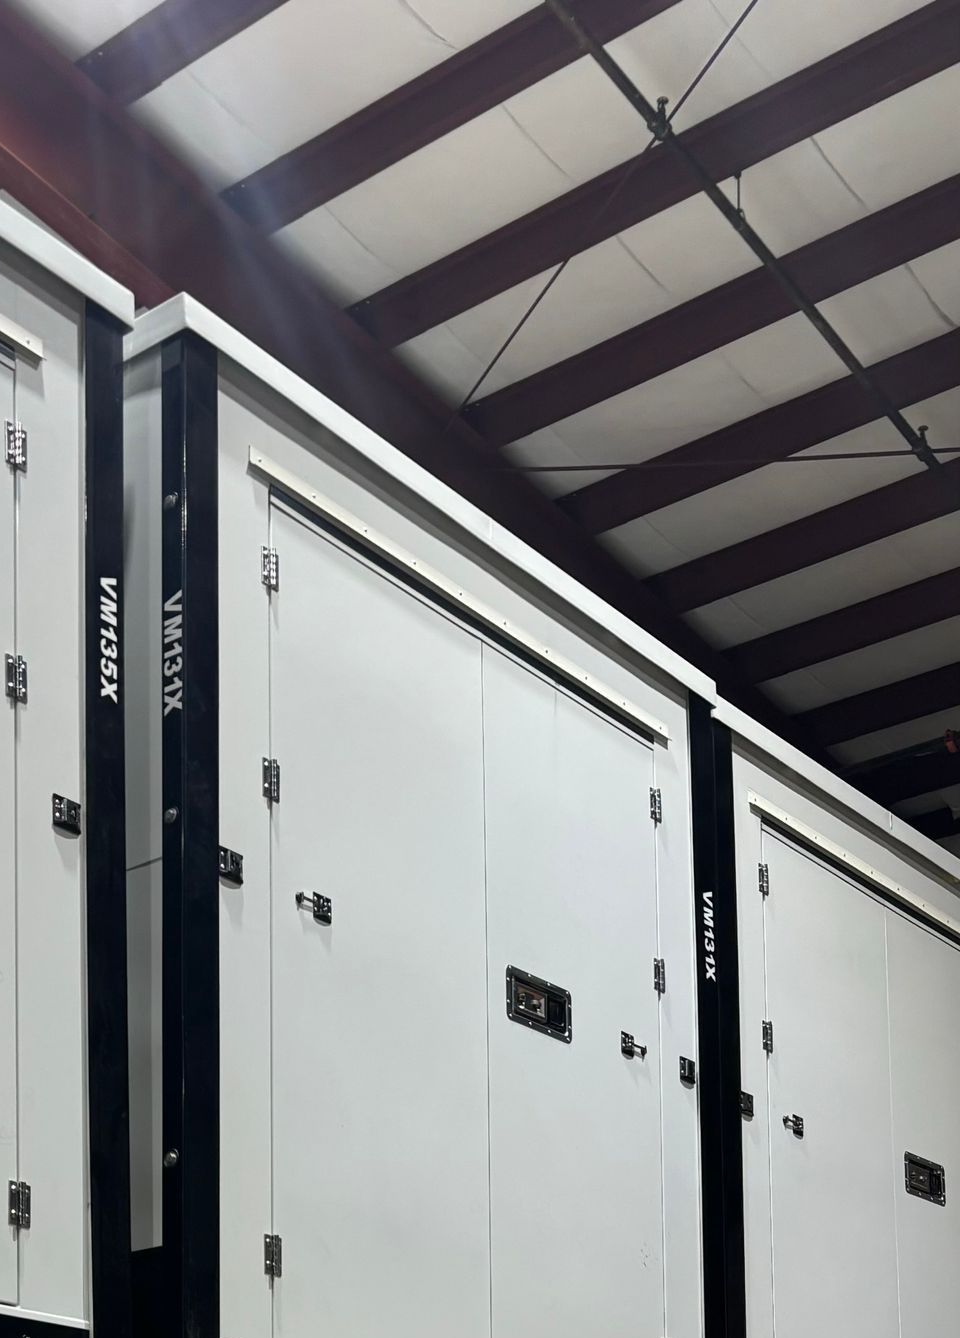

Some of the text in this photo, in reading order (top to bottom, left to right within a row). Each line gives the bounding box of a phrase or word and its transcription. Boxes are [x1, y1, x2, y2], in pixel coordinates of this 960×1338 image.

[100, 577, 118, 704] VM135X
[164, 589, 183, 717] VM131X
[702, 891, 716, 982] VM131X
